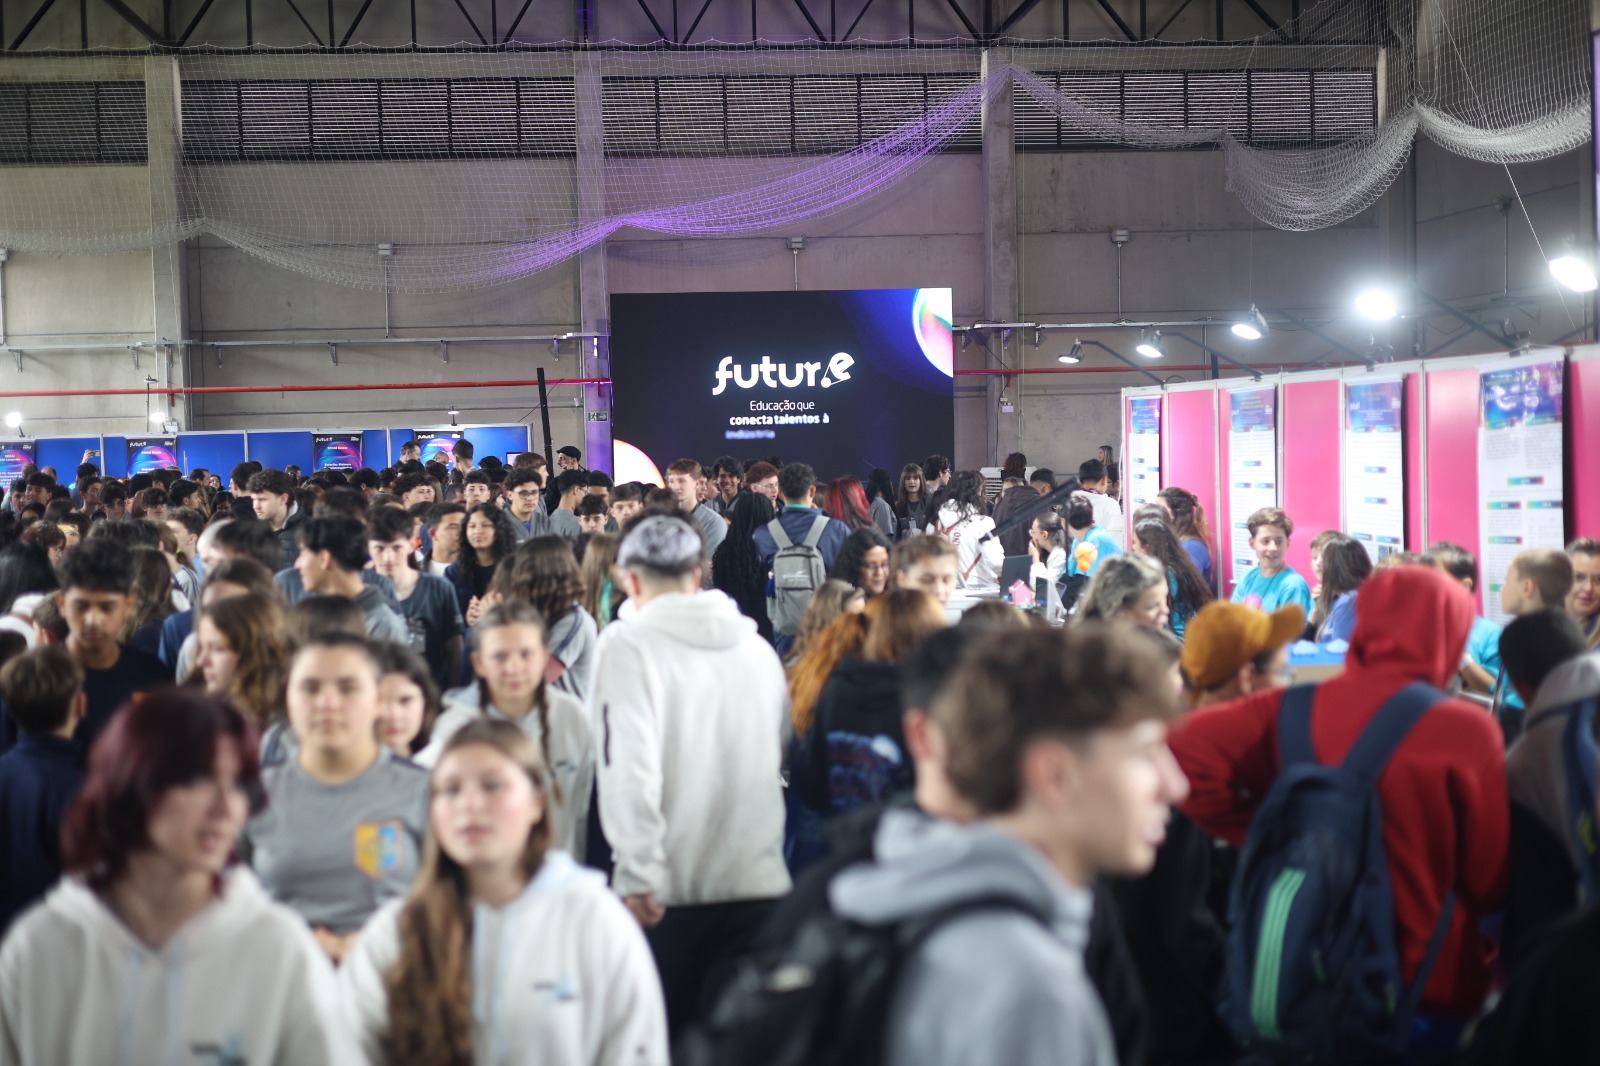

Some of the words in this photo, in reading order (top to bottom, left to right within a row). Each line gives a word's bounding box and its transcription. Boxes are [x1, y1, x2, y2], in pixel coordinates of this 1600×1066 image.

[750, 400, 795, 412] Educação
[797, 401, 815, 412] que
[729, 415, 773, 425] conecta
[774, 414, 820, 425] talentos
[823, 413, 830, 423] à
